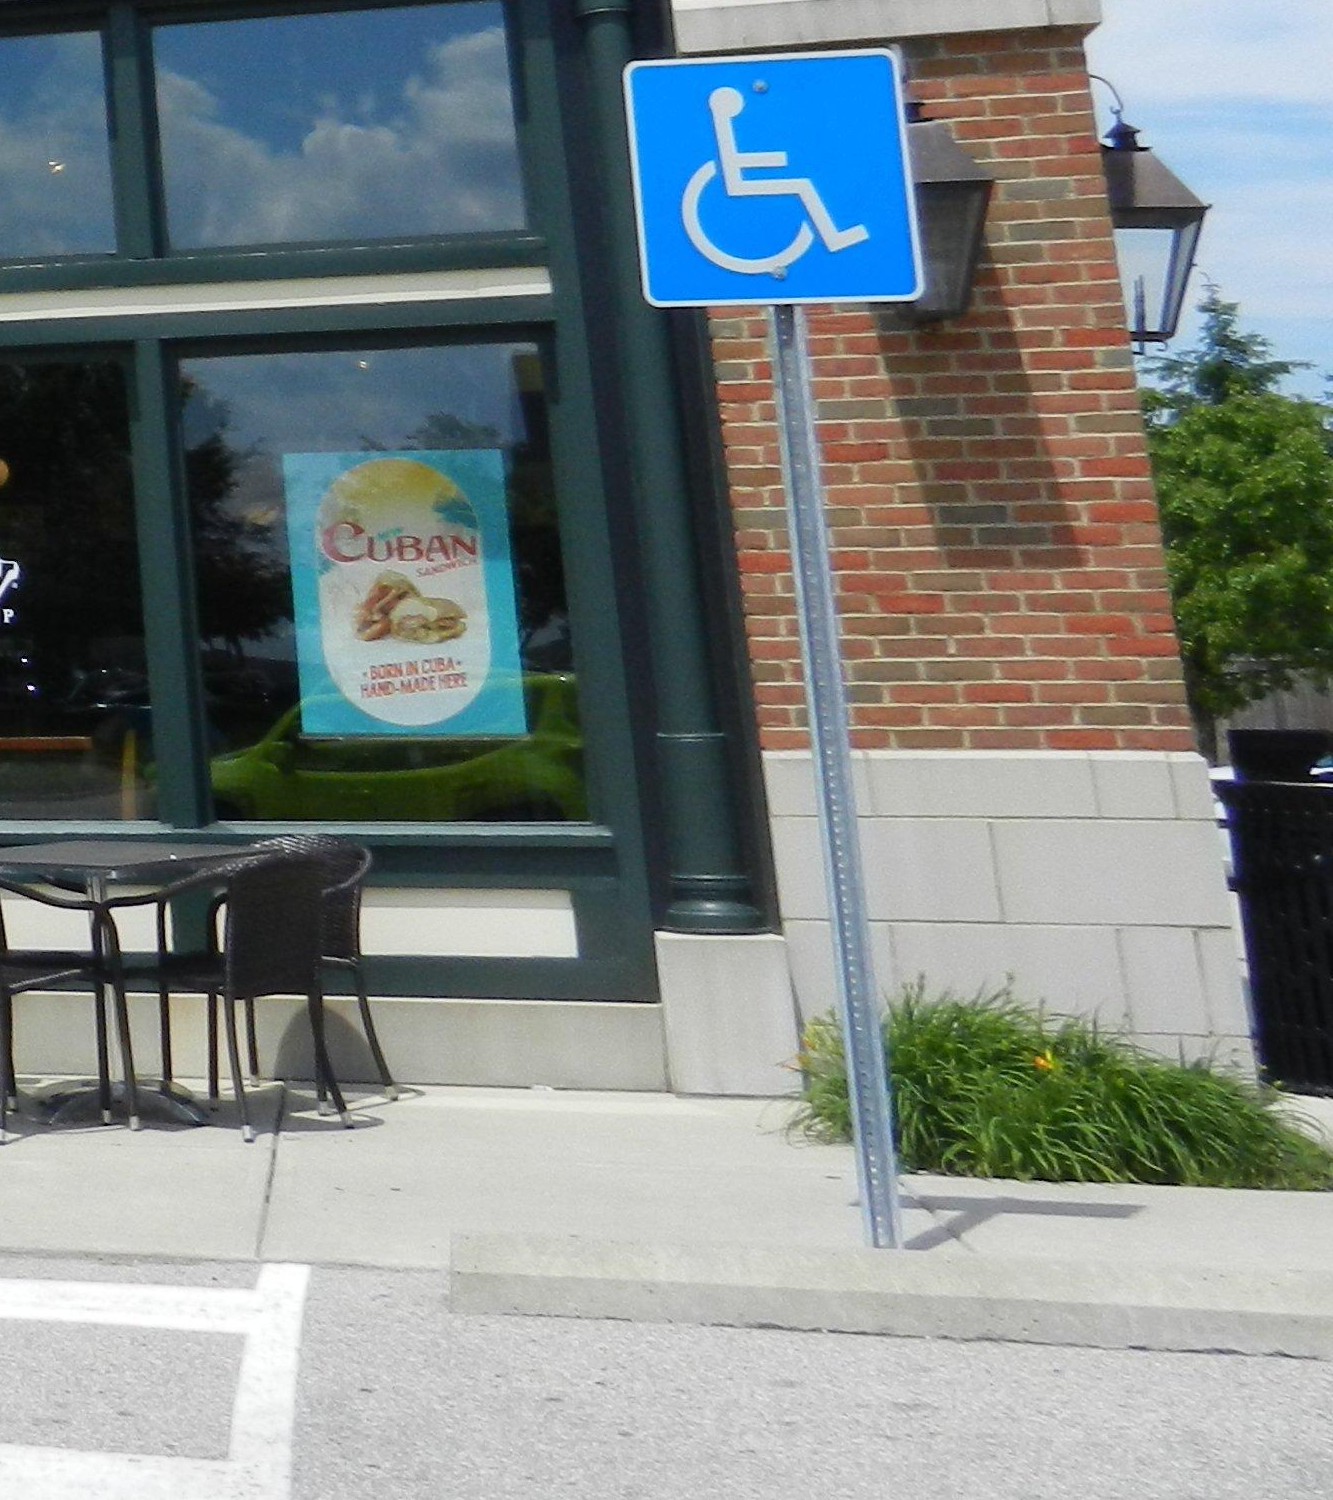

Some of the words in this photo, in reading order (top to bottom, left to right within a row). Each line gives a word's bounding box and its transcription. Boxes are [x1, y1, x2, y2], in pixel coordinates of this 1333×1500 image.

[321, 518, 477, 563] CUBAN
[370, 662, 403, 680] BORN
[405, 660, 419, 676] IN
[421, 657, 455, 674] CUBA
